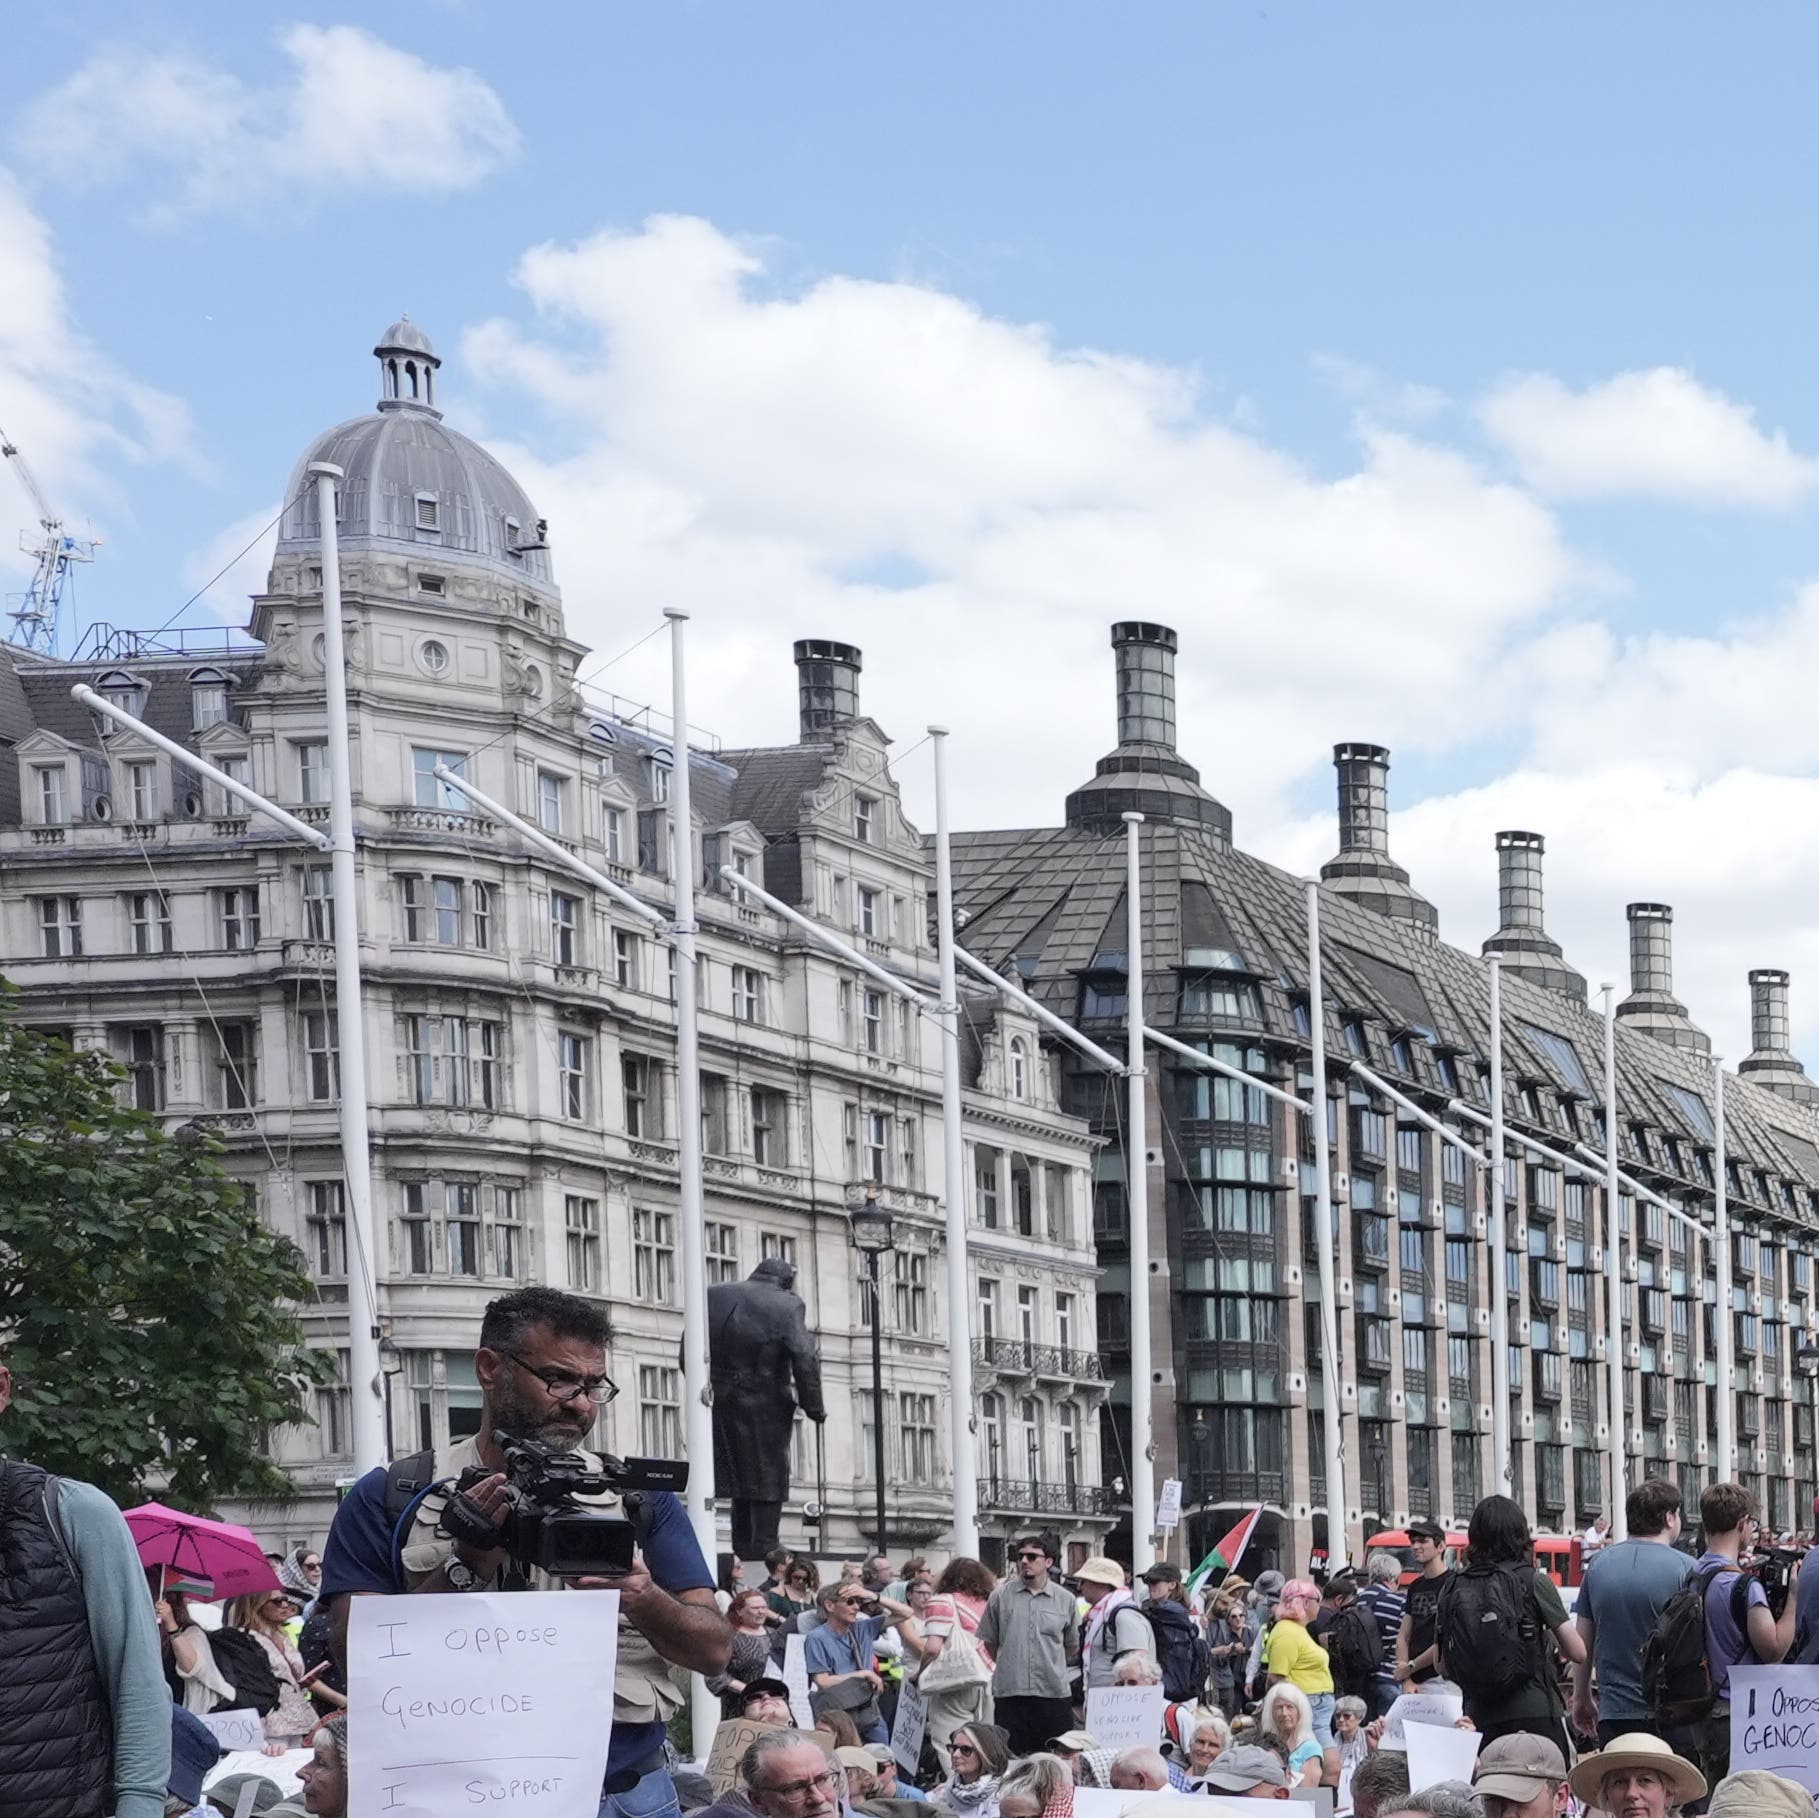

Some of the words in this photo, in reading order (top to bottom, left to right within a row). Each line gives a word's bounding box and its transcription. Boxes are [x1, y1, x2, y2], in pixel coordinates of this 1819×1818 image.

[380, 1622, 410, 1661] I
[1747, 1689, 1757, 1718] I
[381, 1779, 409, 1811] I
[468, 1776, 564, 1806] SUPPORT
